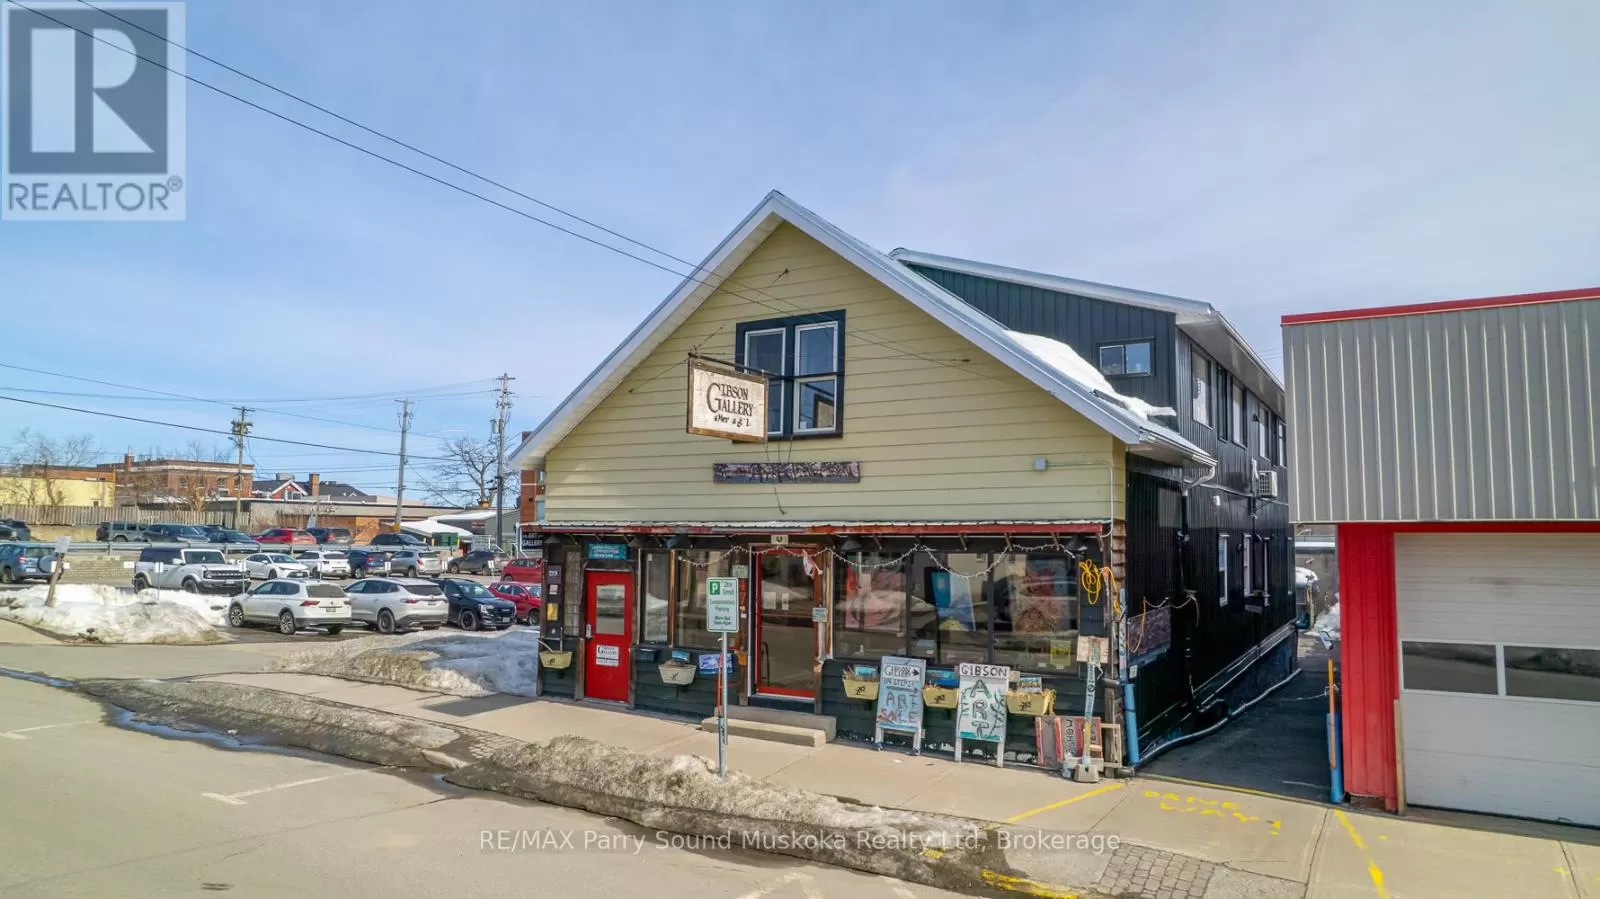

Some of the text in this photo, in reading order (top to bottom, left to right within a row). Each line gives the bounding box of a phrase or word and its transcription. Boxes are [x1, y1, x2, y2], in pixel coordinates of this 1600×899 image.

[706, 382, 749, 401] GIBSON
[706, 397, 754, 417] GALLERY
[961, 665, 1007, 677] GIBSON
[969, 679, 993, 739] ART
